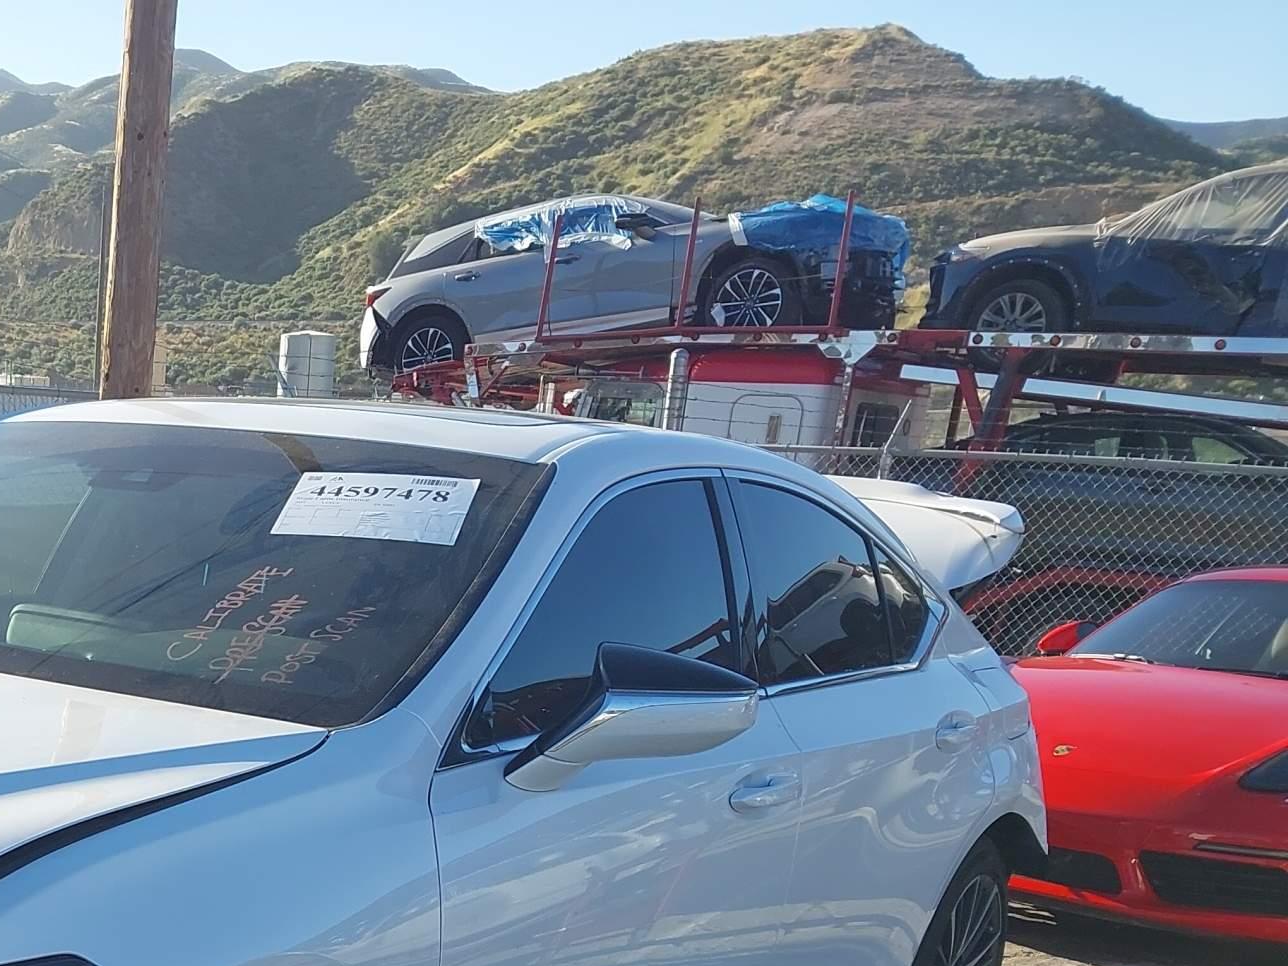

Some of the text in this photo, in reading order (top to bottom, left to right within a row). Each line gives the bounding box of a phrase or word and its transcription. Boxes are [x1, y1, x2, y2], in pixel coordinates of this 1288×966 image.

[310, 484, 451, 503] 44597478
[167, 566, 294, 661] CALIBRATE
[310, 606, 376, 641] SCAN
